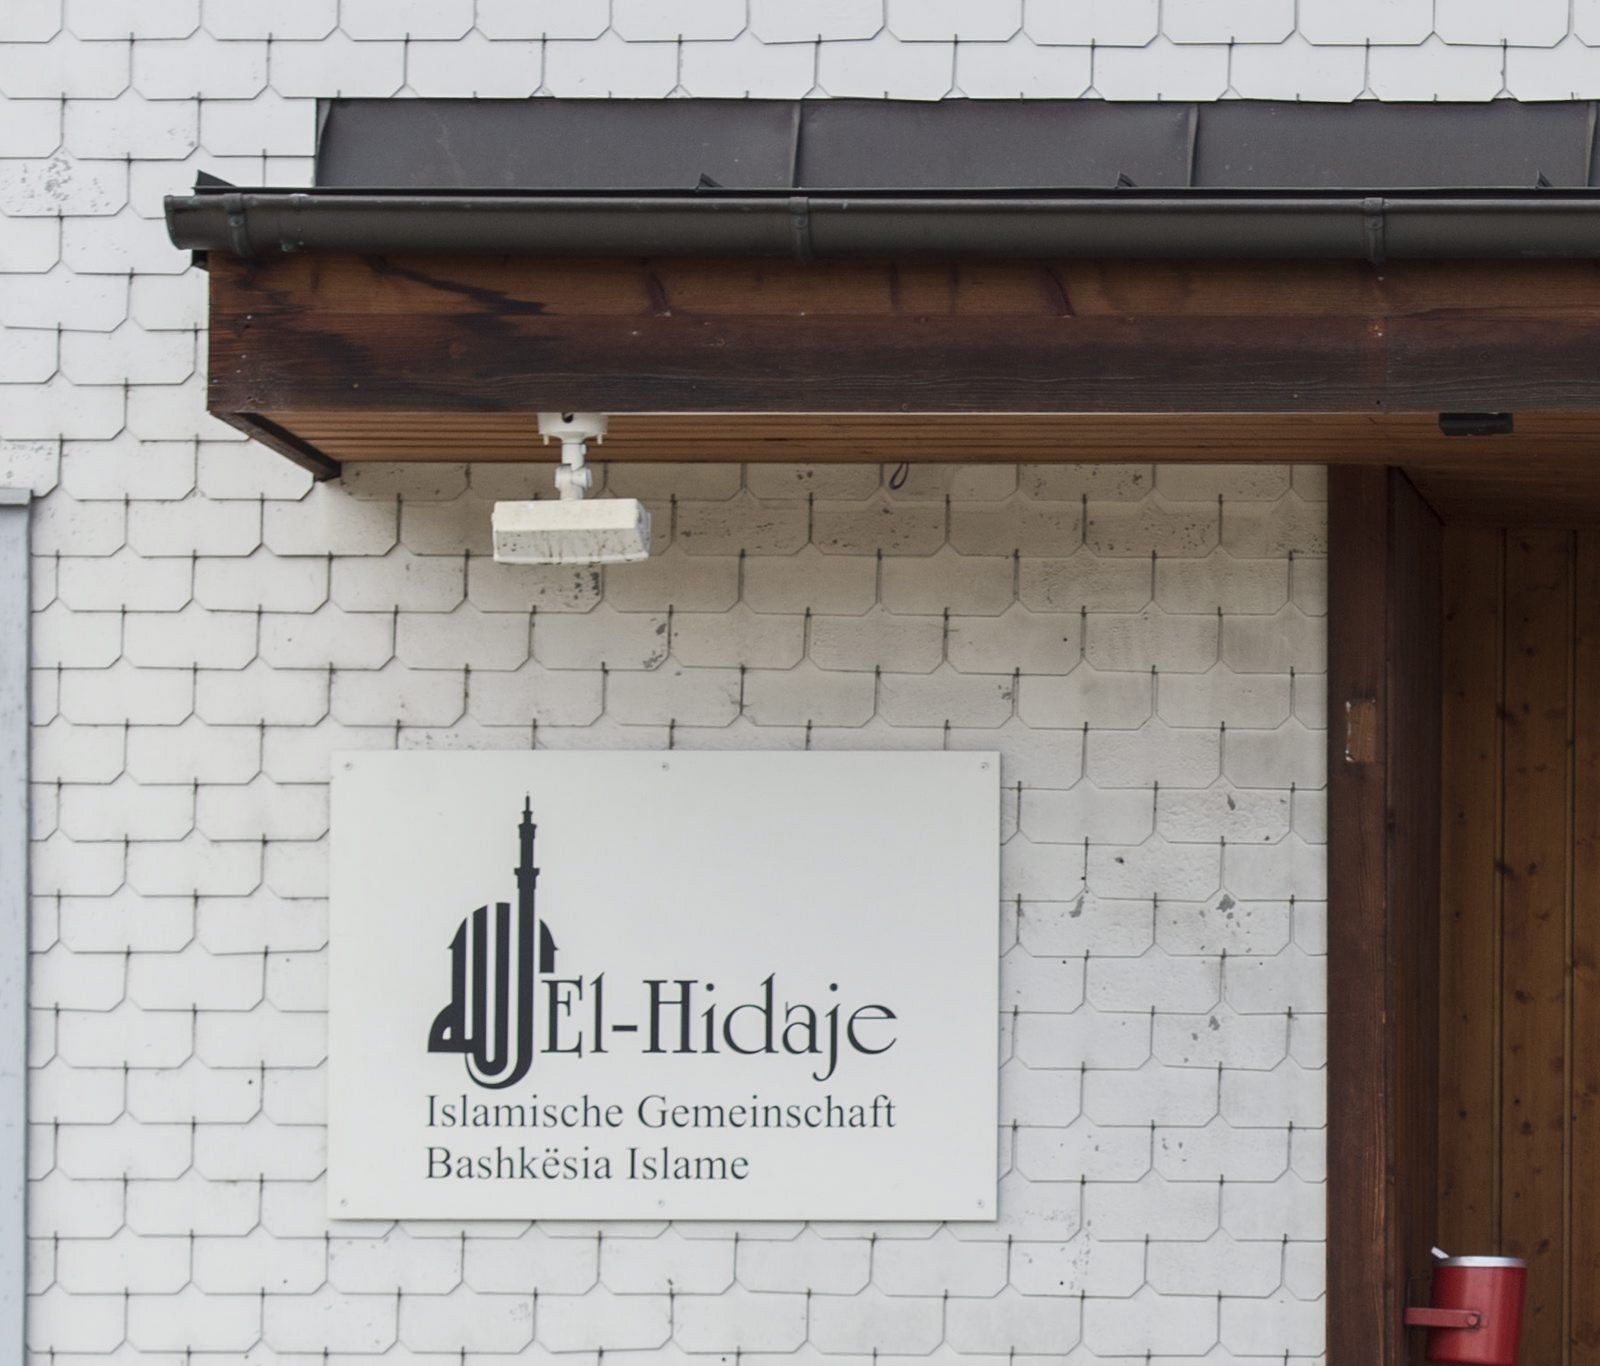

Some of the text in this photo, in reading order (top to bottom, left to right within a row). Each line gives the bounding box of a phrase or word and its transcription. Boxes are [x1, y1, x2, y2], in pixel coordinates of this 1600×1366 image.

[541, 971, 897, 1082] El-Hidaje
[427, 1094, 895, 1128] Islamische Gemeinschaft
[427, 1146, 750, 1180] Bashkësia Islame
